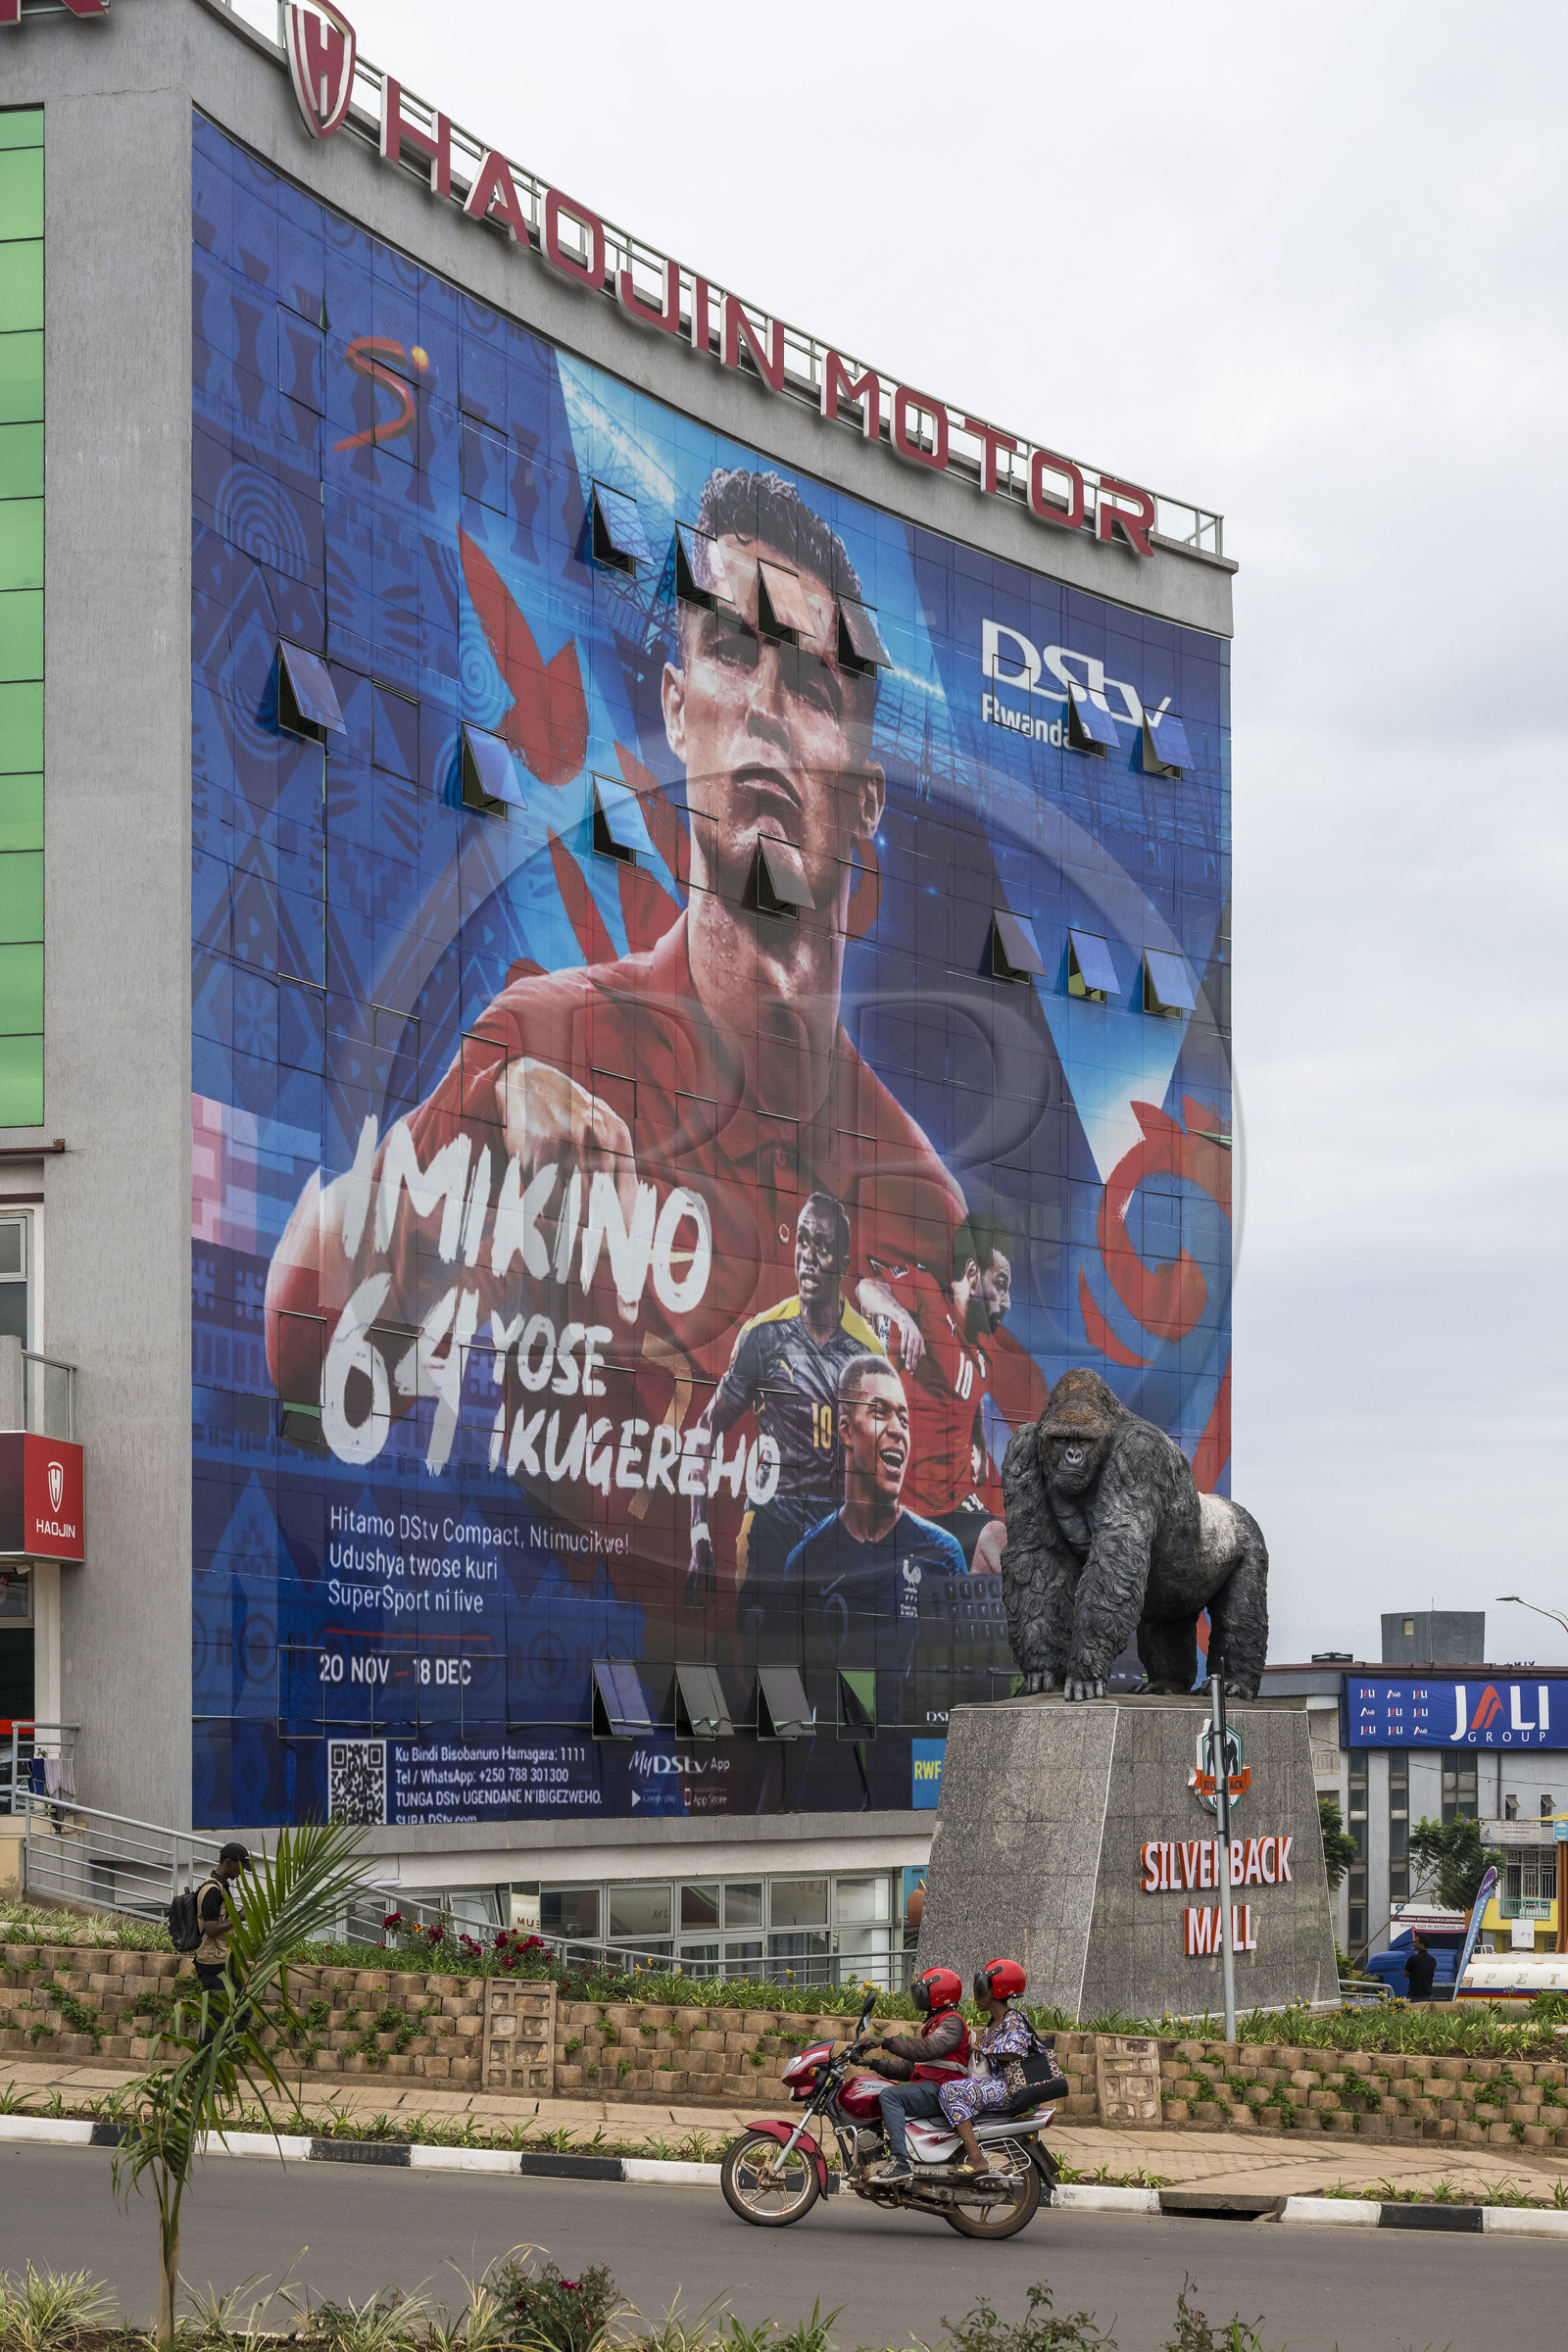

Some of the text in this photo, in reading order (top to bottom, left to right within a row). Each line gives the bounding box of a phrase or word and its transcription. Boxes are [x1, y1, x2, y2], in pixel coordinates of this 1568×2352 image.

[380, 74, 1154, 558] HAOJIN MOTOR
[982, 618, 1171, 728] DStv
[982, 693, 1092, 751] Rwanda
[342, 1114, 712, 1313] IMIKINO
[320, 1272, 480, 1477] 64
[490, 1309, 613, 1396] YOSE
[954, 1352, 973, 1399] 10
[811, 1402, 832, 1448] 10
[489, 1403, 781, 1505] IKUGEREHO
[36, 1519, 75, 1539] HAOJIN
[330, 1505, 629, 1555] Hitamo DStv Compact, Ntimucikwe!
[329, 1544, 498, 1580] Udushya twose kuri
[328, 1579, 483, 1616] SuperSport ni live
[319, 1653, 344, 1683] 20
[351, 1656, 390, 1684] NOV
[413, 1658, 431, 1685] 18
[435, 1658, 471, 1686] DEC
[1450, 1685, 1549, 1740] JALI
[395, 1746, 585, 1764] Ku Bindi Bisobanuro Hamagara: 1111
[1467, 1732, 1546, 1742] GROUP
[396, 1769, 410, 1785] Tel
[420, 1768, 476, 1787] WhatsApp:
[479, 1768, 505, 1783] +250
[509, 1768, 527, 1782] 788
[530, 1768, 569, 1783] 301300
[710, 1757, 730, 1772] App
[914, 1760, 942, 1780] RWF
[396, 1791, 433, 1807] TUNGA
[436, 1791, 460, 1806] DStv
[463, 1789, 522, 1805] UGENDANE
[1141, 1837, 1293, 1891] SILVEBACK
